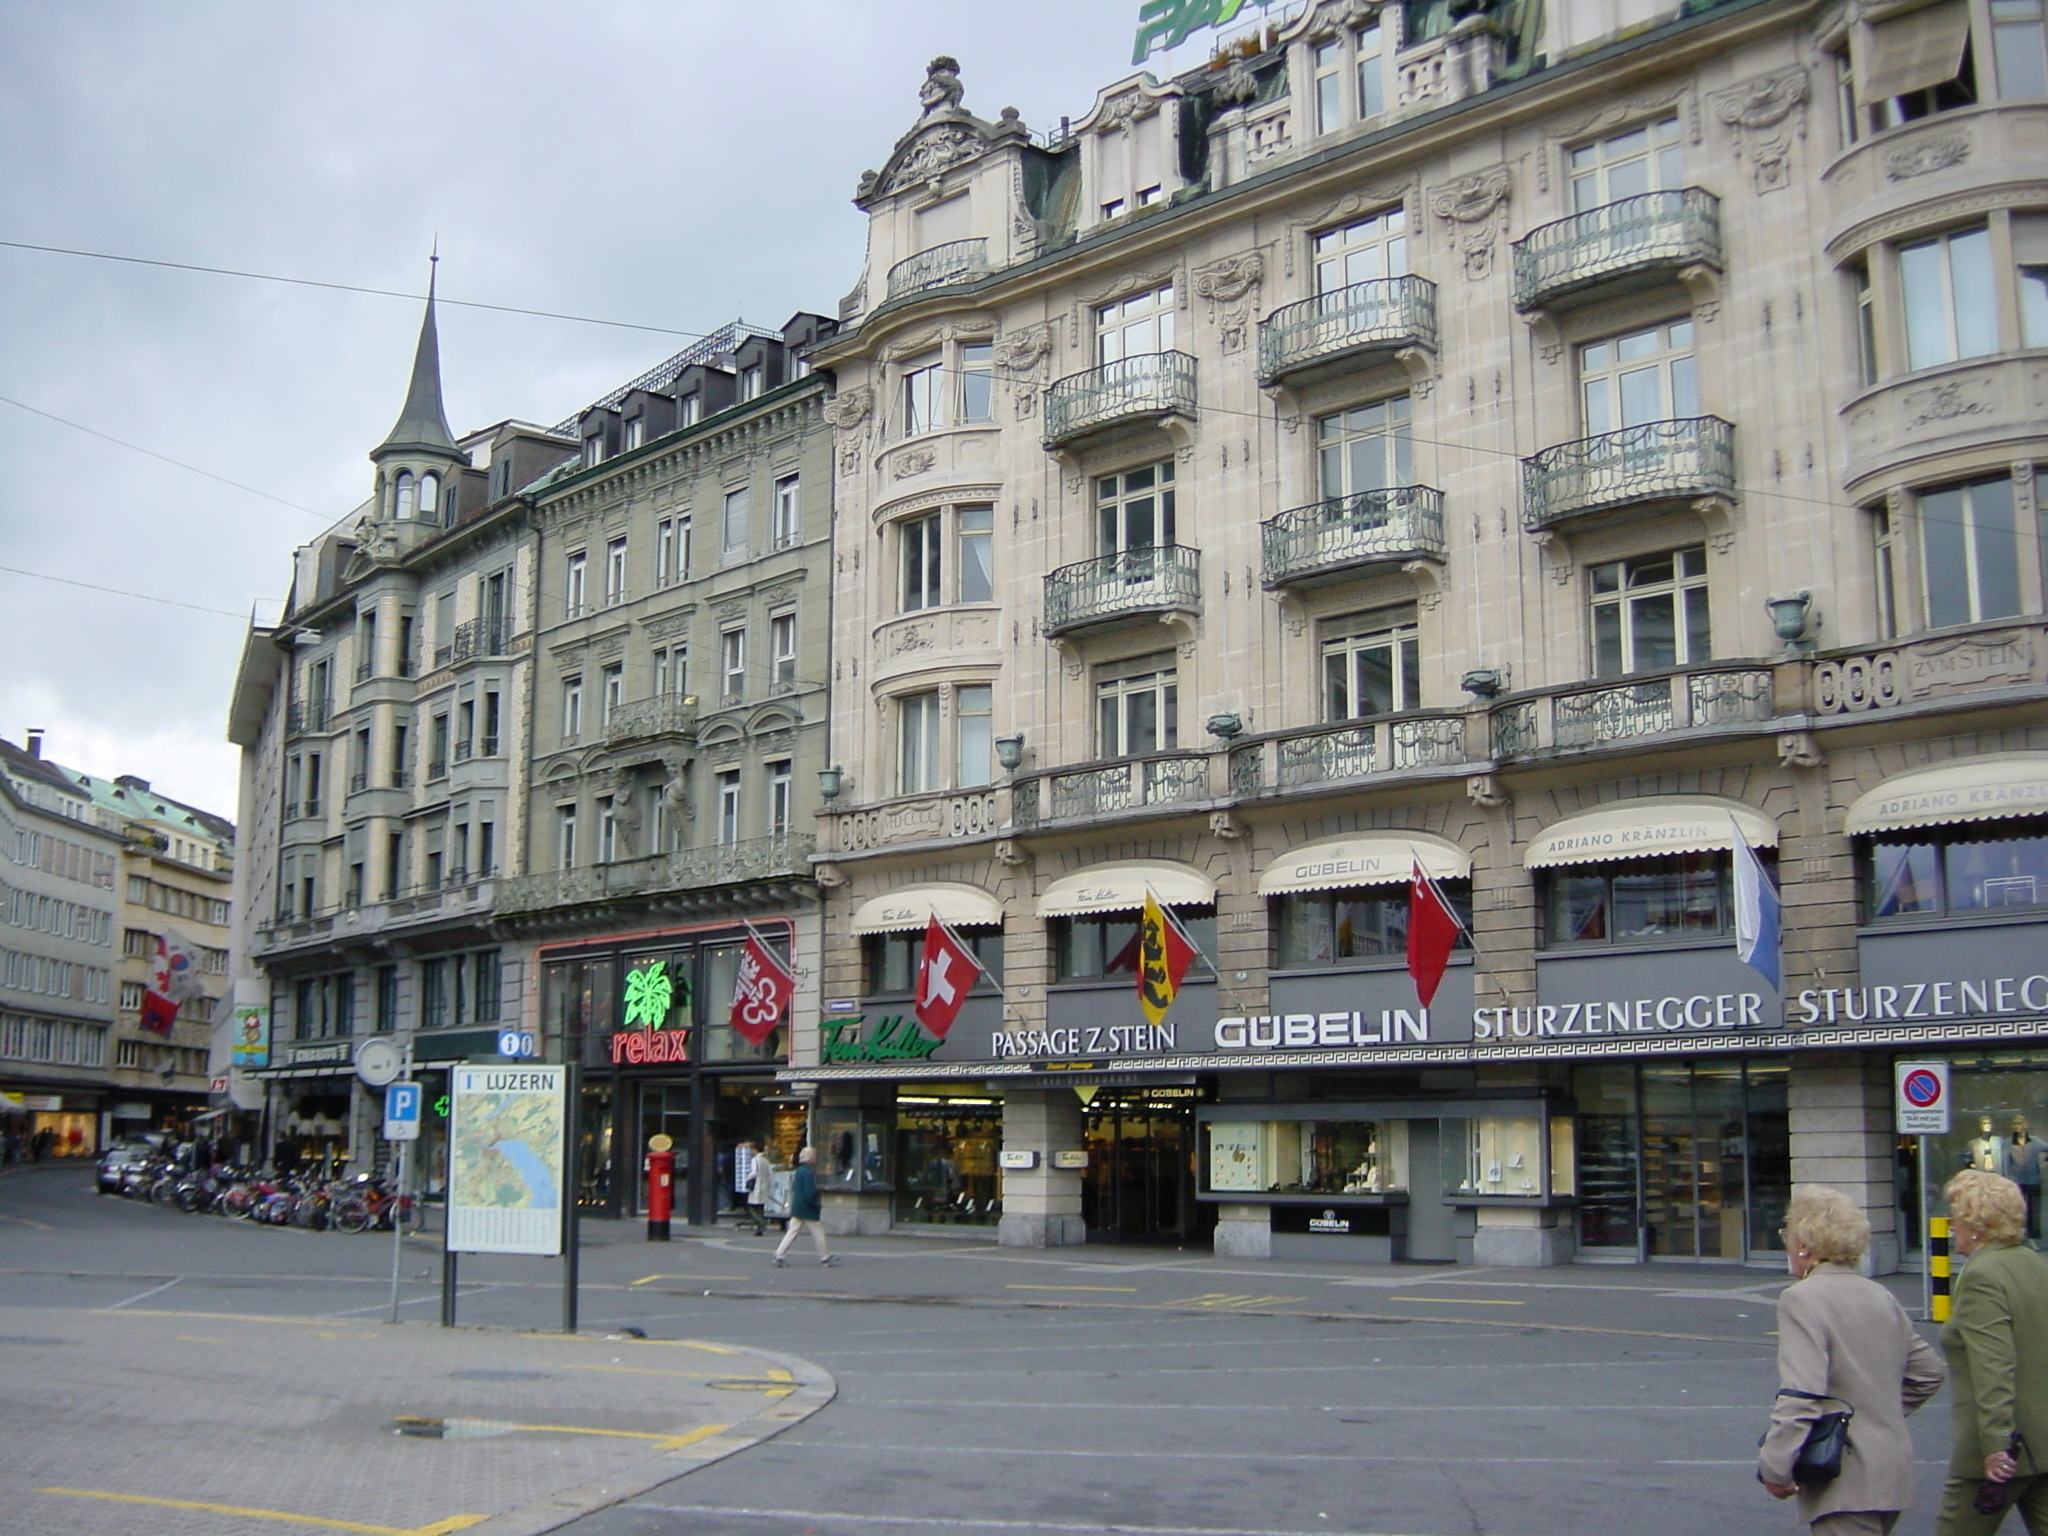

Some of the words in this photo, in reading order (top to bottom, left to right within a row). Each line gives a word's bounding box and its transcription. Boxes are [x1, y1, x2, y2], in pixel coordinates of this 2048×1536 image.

[1960, 644, 2024, 669] STEIN
[1879, 793, 1958, 816] ADRIANO
[1549, 833, 1613, 853] ADRIANO
[1622, 826, 1708, 843] KRÄNZLIN
[1295, 858, 1380, 878] GÜBELIN
[1213, 1007, 1429, 1048] GÜBELIN
[1472, 993, 1764, 1039] STURZENEGGER
[613, 1023, 688, 1064] relax
[992, 1027, 1079, 1057] PASSAGE
[487, 1073, 554, 1090] LUZERN
[395, 1090, 412, 1119] P
